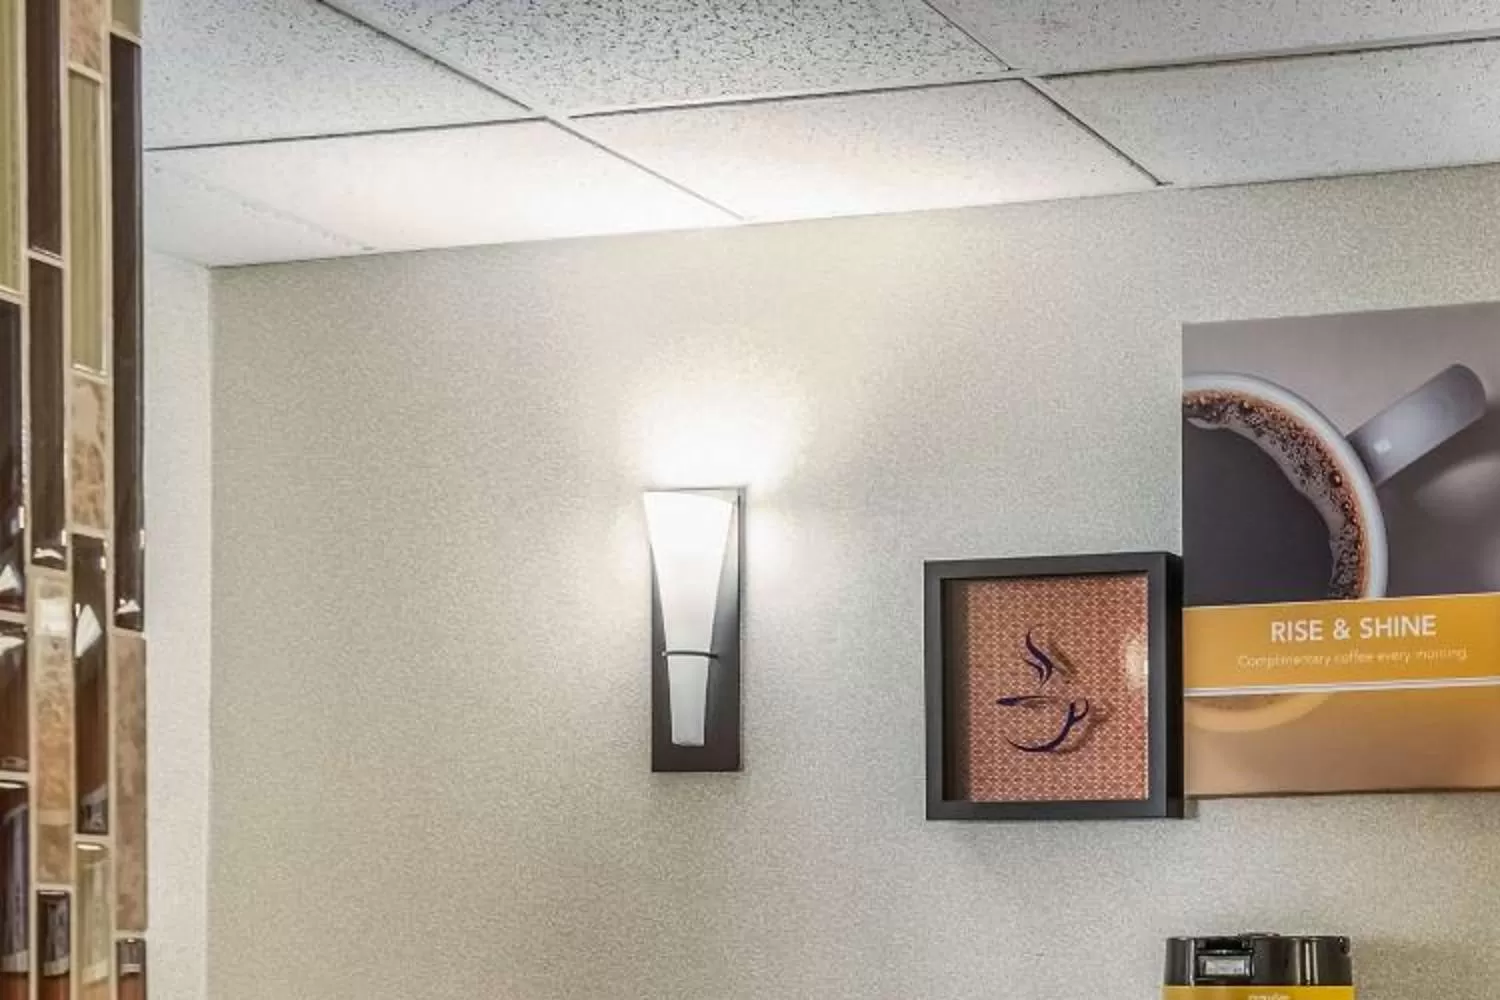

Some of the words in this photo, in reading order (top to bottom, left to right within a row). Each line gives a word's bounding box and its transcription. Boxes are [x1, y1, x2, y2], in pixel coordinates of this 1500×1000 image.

[1271, 619, 1324, 642] RISE
[1332, 617, 1351, 640] &
[1359, 614, 1437, 640] SHINE
[1237, 654, 1332, 669] Complimentary
[1335, 649, 1373, 663] coffee
[1377, 652, 1410, 664] every
